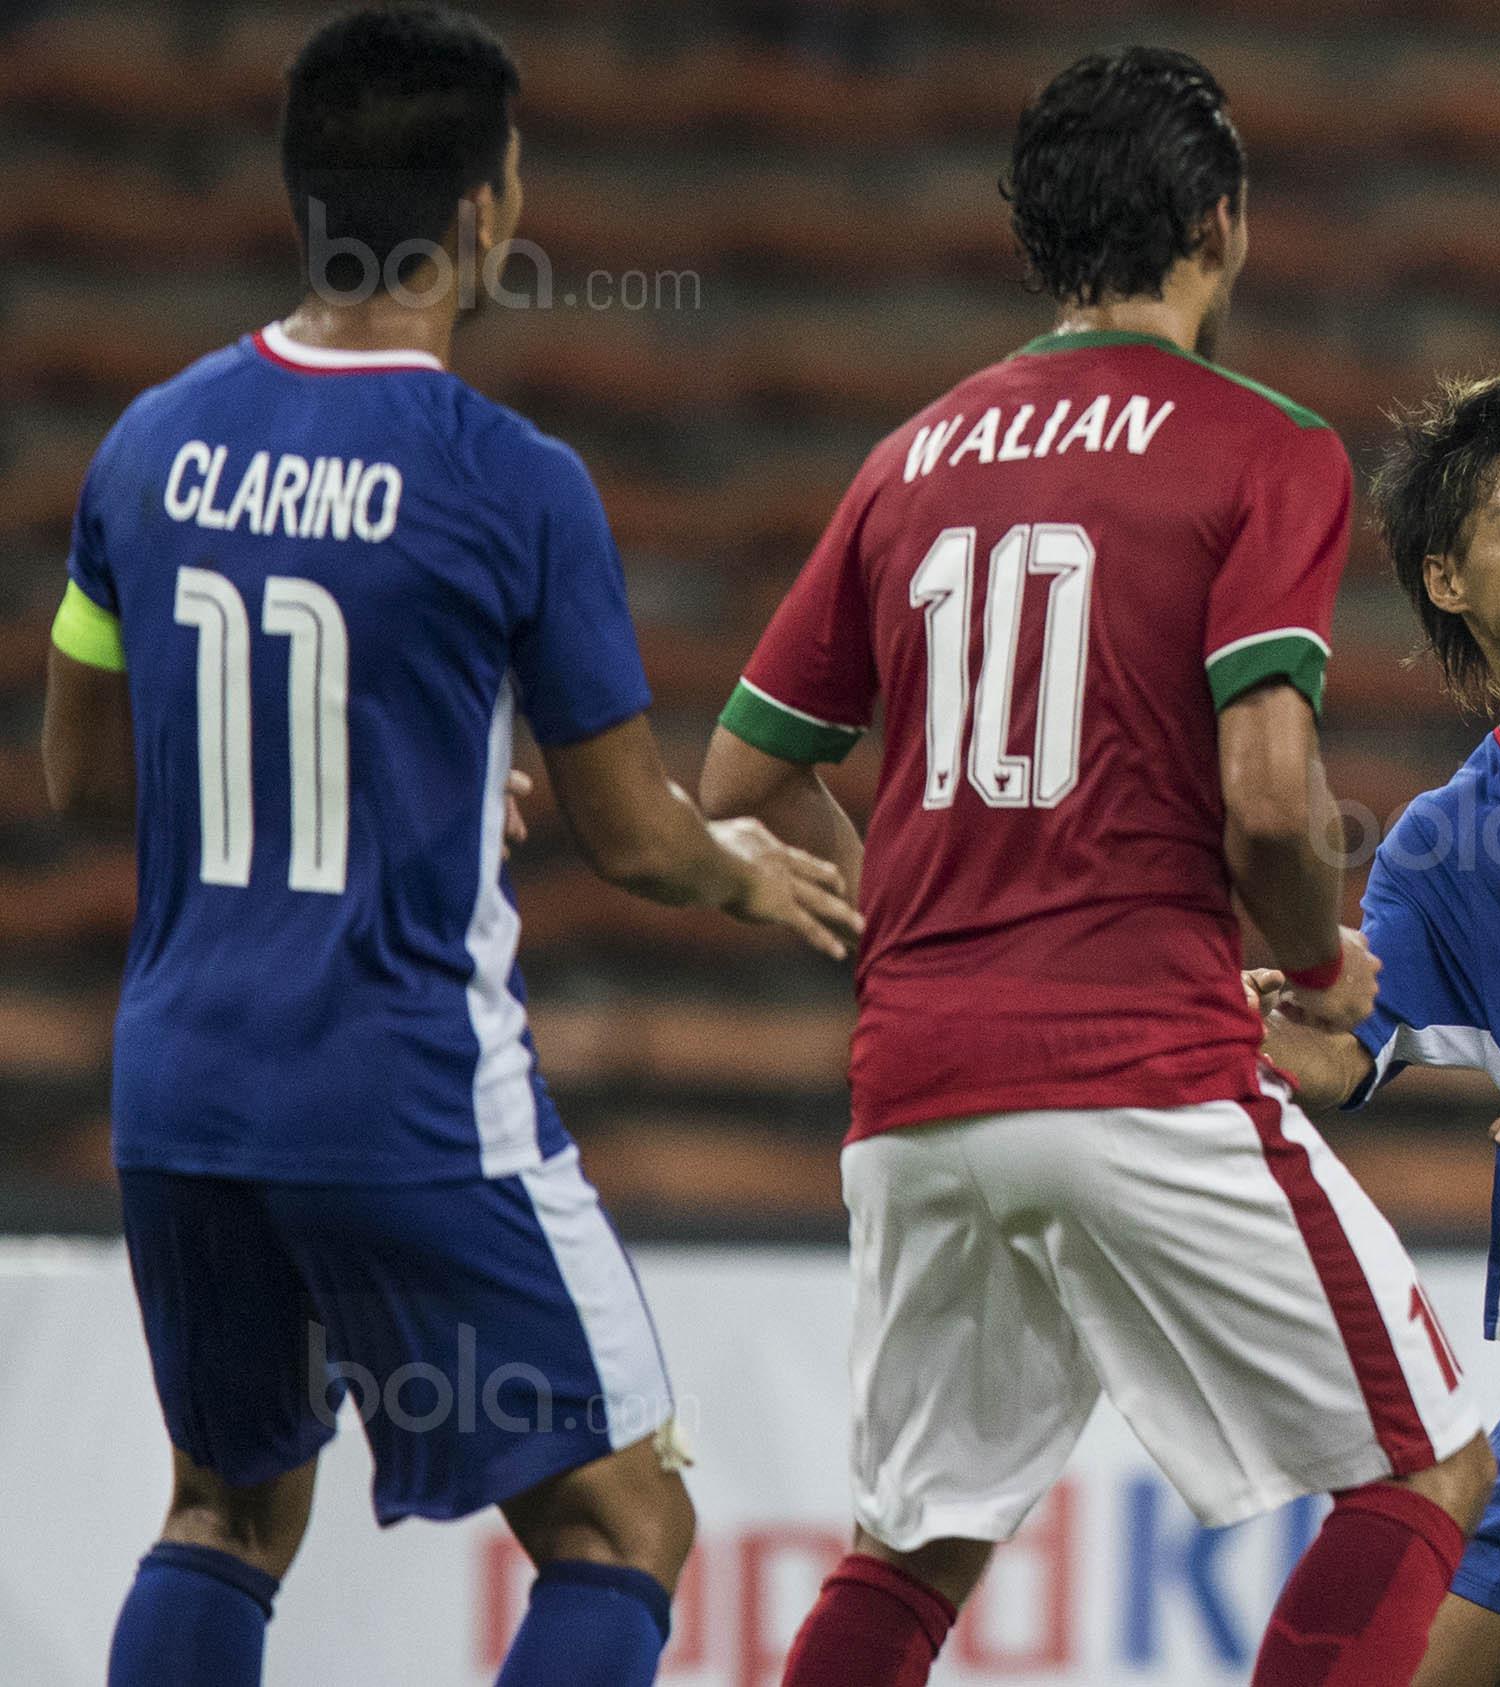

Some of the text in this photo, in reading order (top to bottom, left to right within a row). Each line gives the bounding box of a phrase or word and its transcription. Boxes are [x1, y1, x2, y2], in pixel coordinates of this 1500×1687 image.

[163, 440, 402, 544] CLARINO
[902, 395, 1176, 482] WALIAN
[909, 523, 1096, 810] 10
[173, 566, 349, 895] 11
[1408, 1280, 1464, 1395] 1
